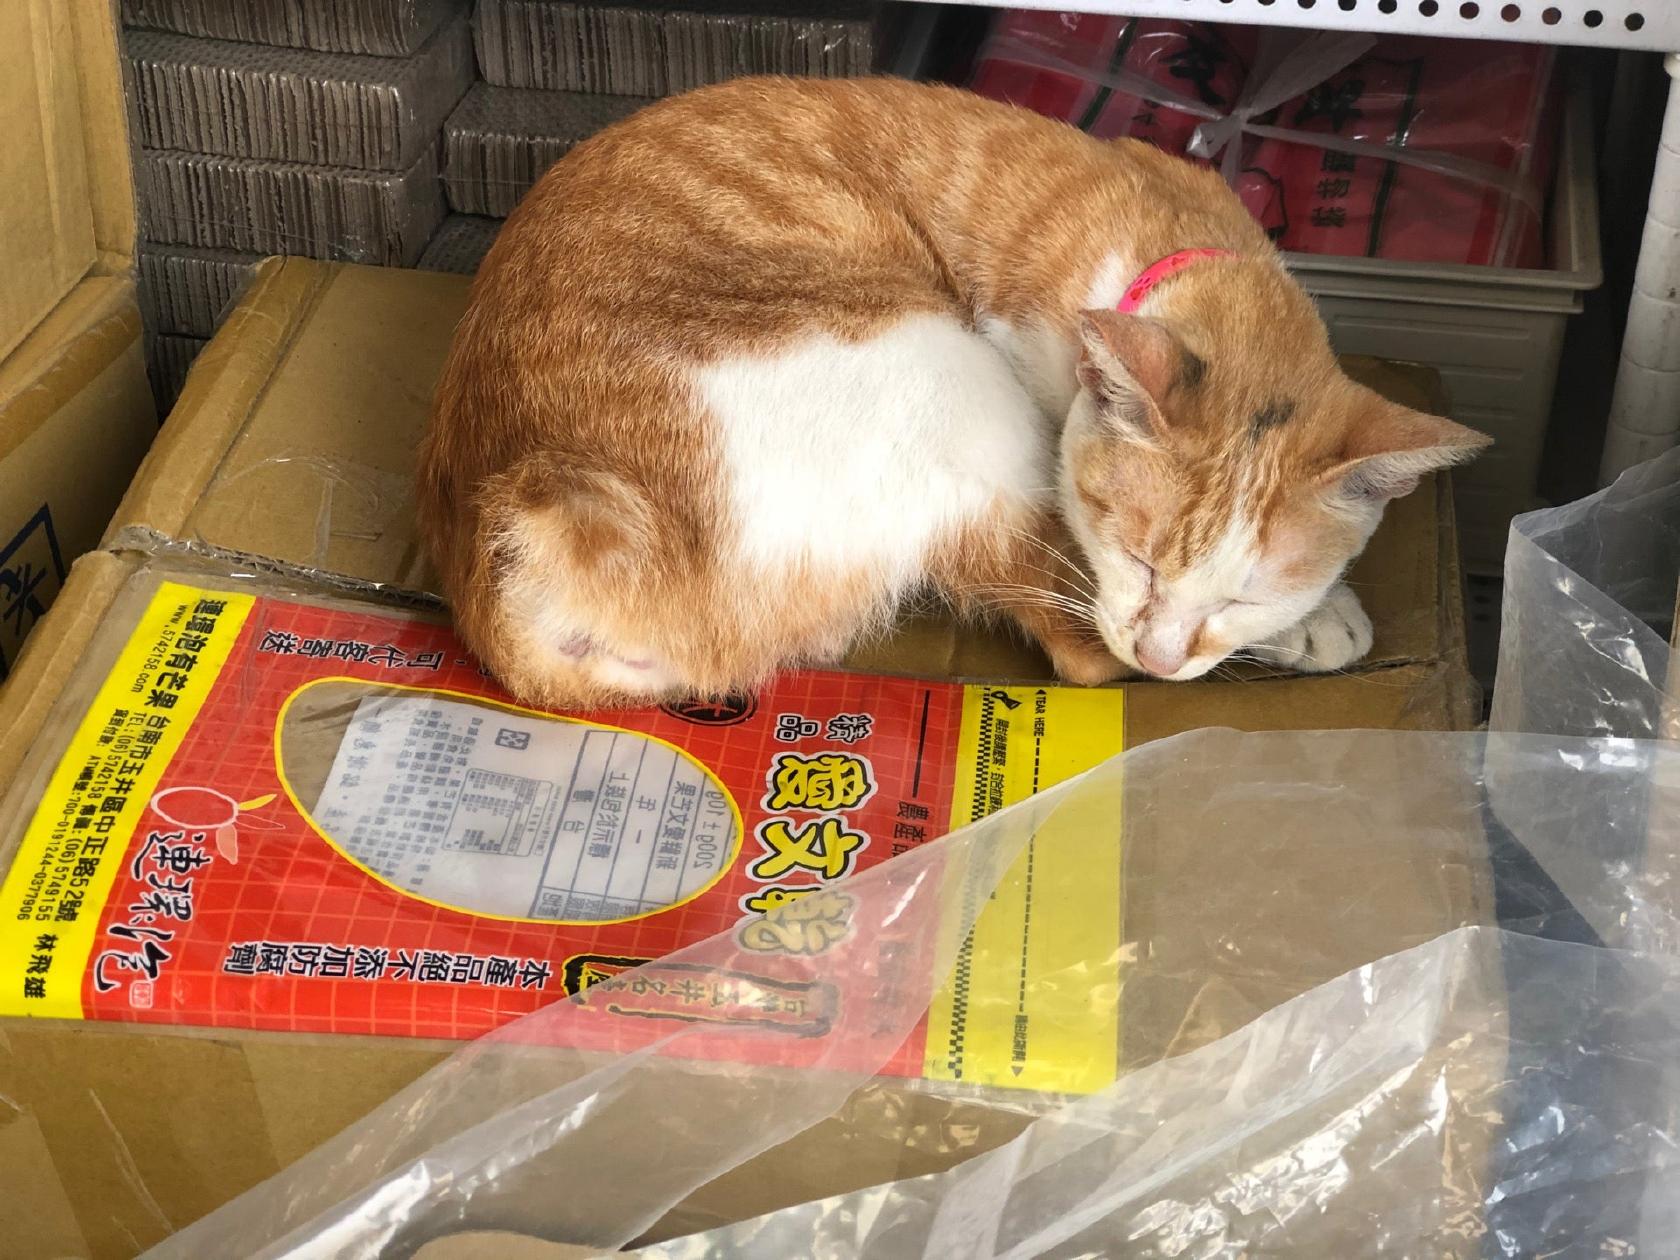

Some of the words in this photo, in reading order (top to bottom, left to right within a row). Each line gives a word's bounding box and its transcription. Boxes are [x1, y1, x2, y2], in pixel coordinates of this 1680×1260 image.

[259, 632, 445, 669] 可代客寄送
[1035, 696, 1046, 714] TEAR
[776, 714, 873, 744] 精品
[1033, 717, 1045, 737] HERE
[54, 715, 171, 922] 台南市玉井區中正路52號
[23, 933, 59, 999] 林飛雄
[224, 942, 551, 991] 本產品絕不添加防腐劑
